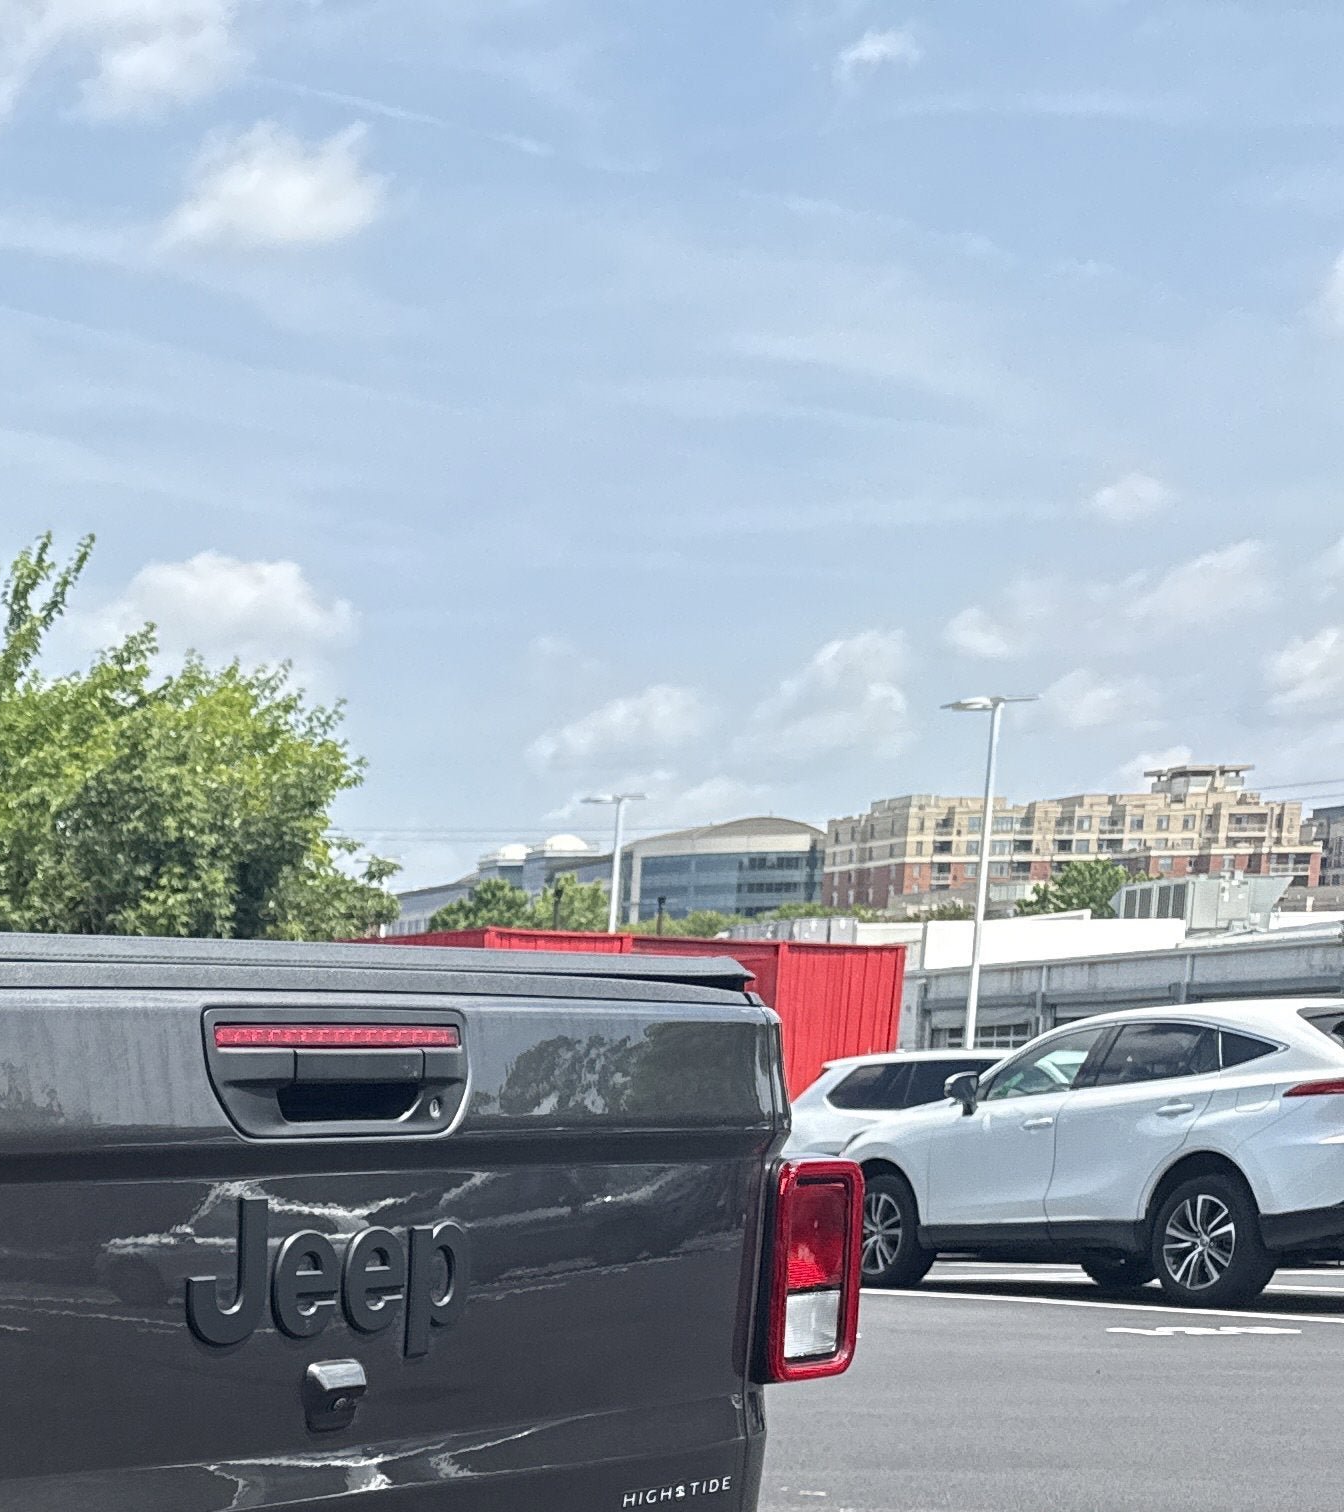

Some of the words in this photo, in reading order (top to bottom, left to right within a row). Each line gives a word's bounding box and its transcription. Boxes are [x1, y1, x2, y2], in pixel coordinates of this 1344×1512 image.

[185, 1196, 468, 1357] Jeep
[622, 1487, 673, 1508] HIGH
[690, 1475, 732, 1495] TIDE
